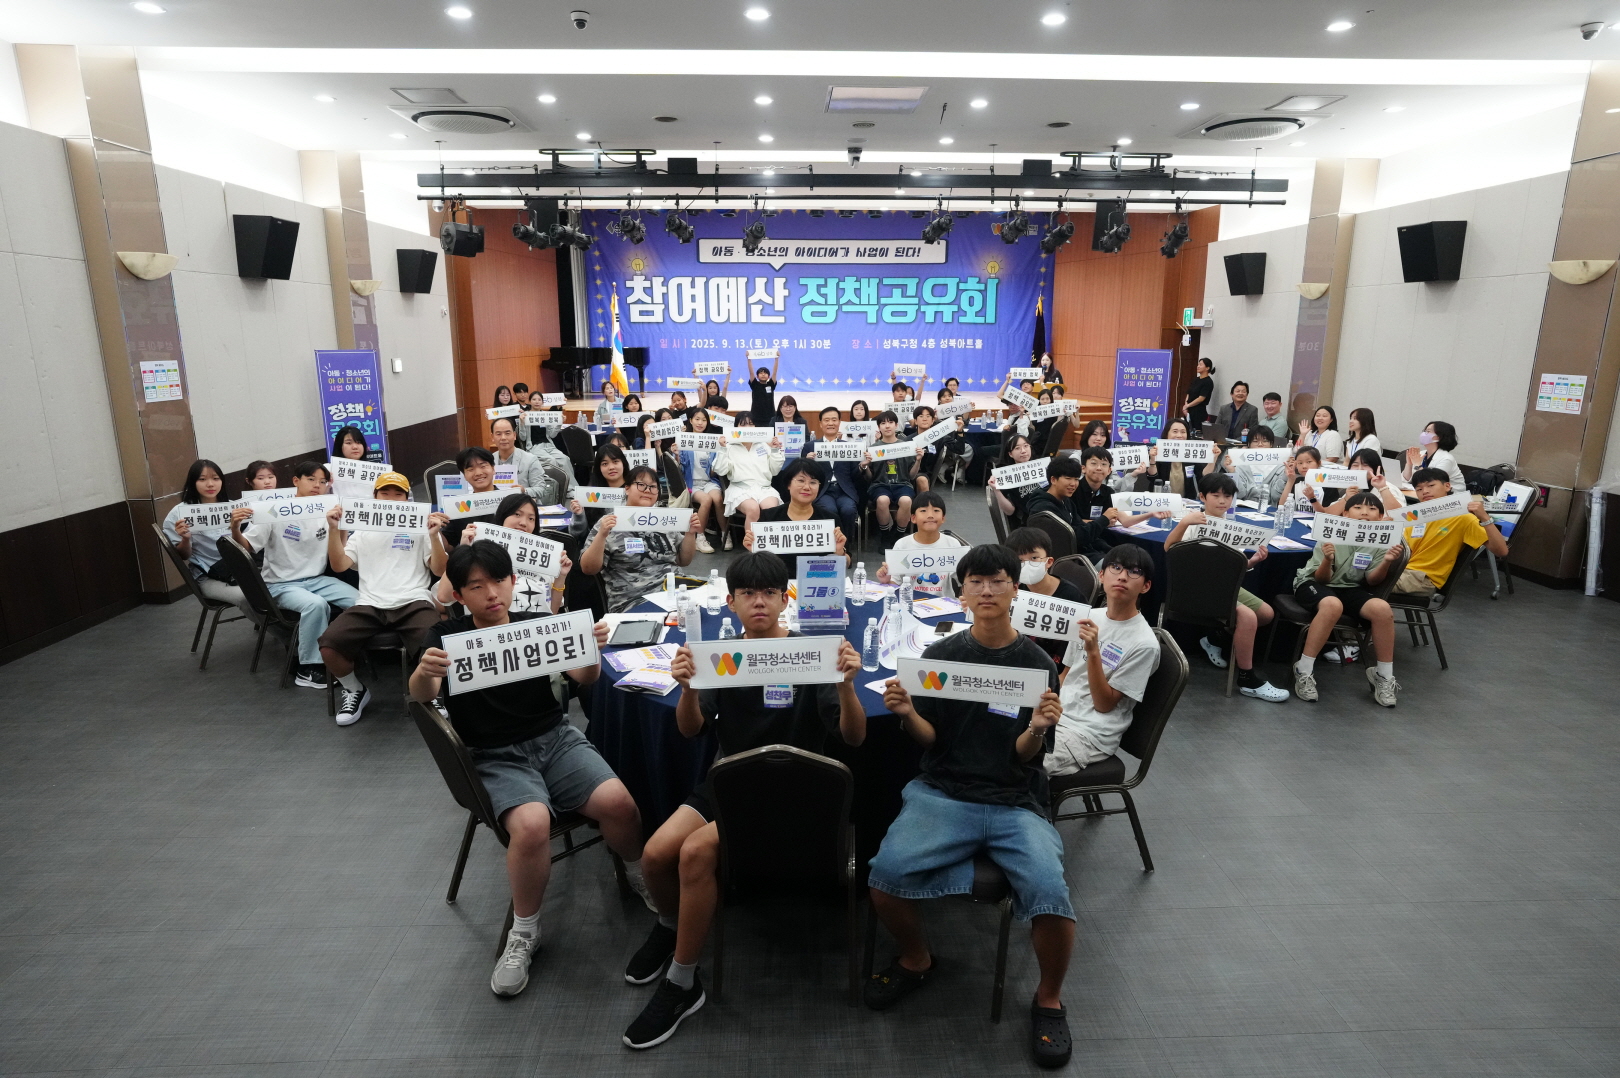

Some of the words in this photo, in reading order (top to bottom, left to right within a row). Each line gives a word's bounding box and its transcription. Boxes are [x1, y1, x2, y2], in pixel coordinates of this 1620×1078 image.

[712, 246, 734, 257] 아동
[794, 246, 850, 258] 아이디어가
[856, 246, 889, 258] 사업이
[895, 246, 922, 258] 된다!
[625, 276, 789, 323] 참여예산
[799, 276, 998, 324] 정책공유회
[691, 339, 717, 349] 2025.
[722, 339, 731, 349] 9.
[772, 339, 790, 349] 오후
[793, 339, 808, 349] 1시
[810, 339, 832, 349] 30분
[883, 339, 918, 350] 성북구청
[922, 339, 936, 350] 4층
[940, 339, 983, 350] 성북아트홀
[328, 403, 365, 421] 정책
[1118, 397, 1152, 413] 정책
[1117, 413, 1161, 430] 공유회
[817, 450, 862, 458] 정책사업으로!
[1119, 454, 1141, 466] 공유회
[1163, 449, 1180, 458] 정책
[1184, 449, 1207, 459] 공유회
[1247, 452, 1264, 462] sb
[1266, 453, 1280, 461] 성북
[338, 467, 356, 479] 정책
[1134, 496, 1153, 507] sb
[1154, 498, 1170, 507] 성북
[279, 502, 303, 517] sb
[305, 503, 325, 514] 성북
[345, 510, 423, 528] 정책사업으로!
[638, 512, 658, 526] sb
[660, 516, 678, 526] 성북
[757, 533, 830, 549] 정책사업으로!
[1198, 527, 1265, 546] 정책사업으로!
[1322, 526, 1348, 540] 정책
[1355, 531, 1391, 545] 공유회
[516, 546, 551, 568] 공유회
[912, 554, 935, 568] sb
[936, 555, 956, 567] 성북
[804, 587, 829, 598] 그룹
[1028, 597, 1047, 609] 청소년
[1024, 610, 1070, 635] 공유회
[466, 637, 484, 650] 아동
[497, 628, 531, 644] 청소년의
[536, 621, 572, 636] 목소리가!
[454, 634, 586, 683] 정책사업으로!
[746, 651, 821, 667] 월곡청소년센터
[951, 674, 1025, 691] 월곡청소년센터
